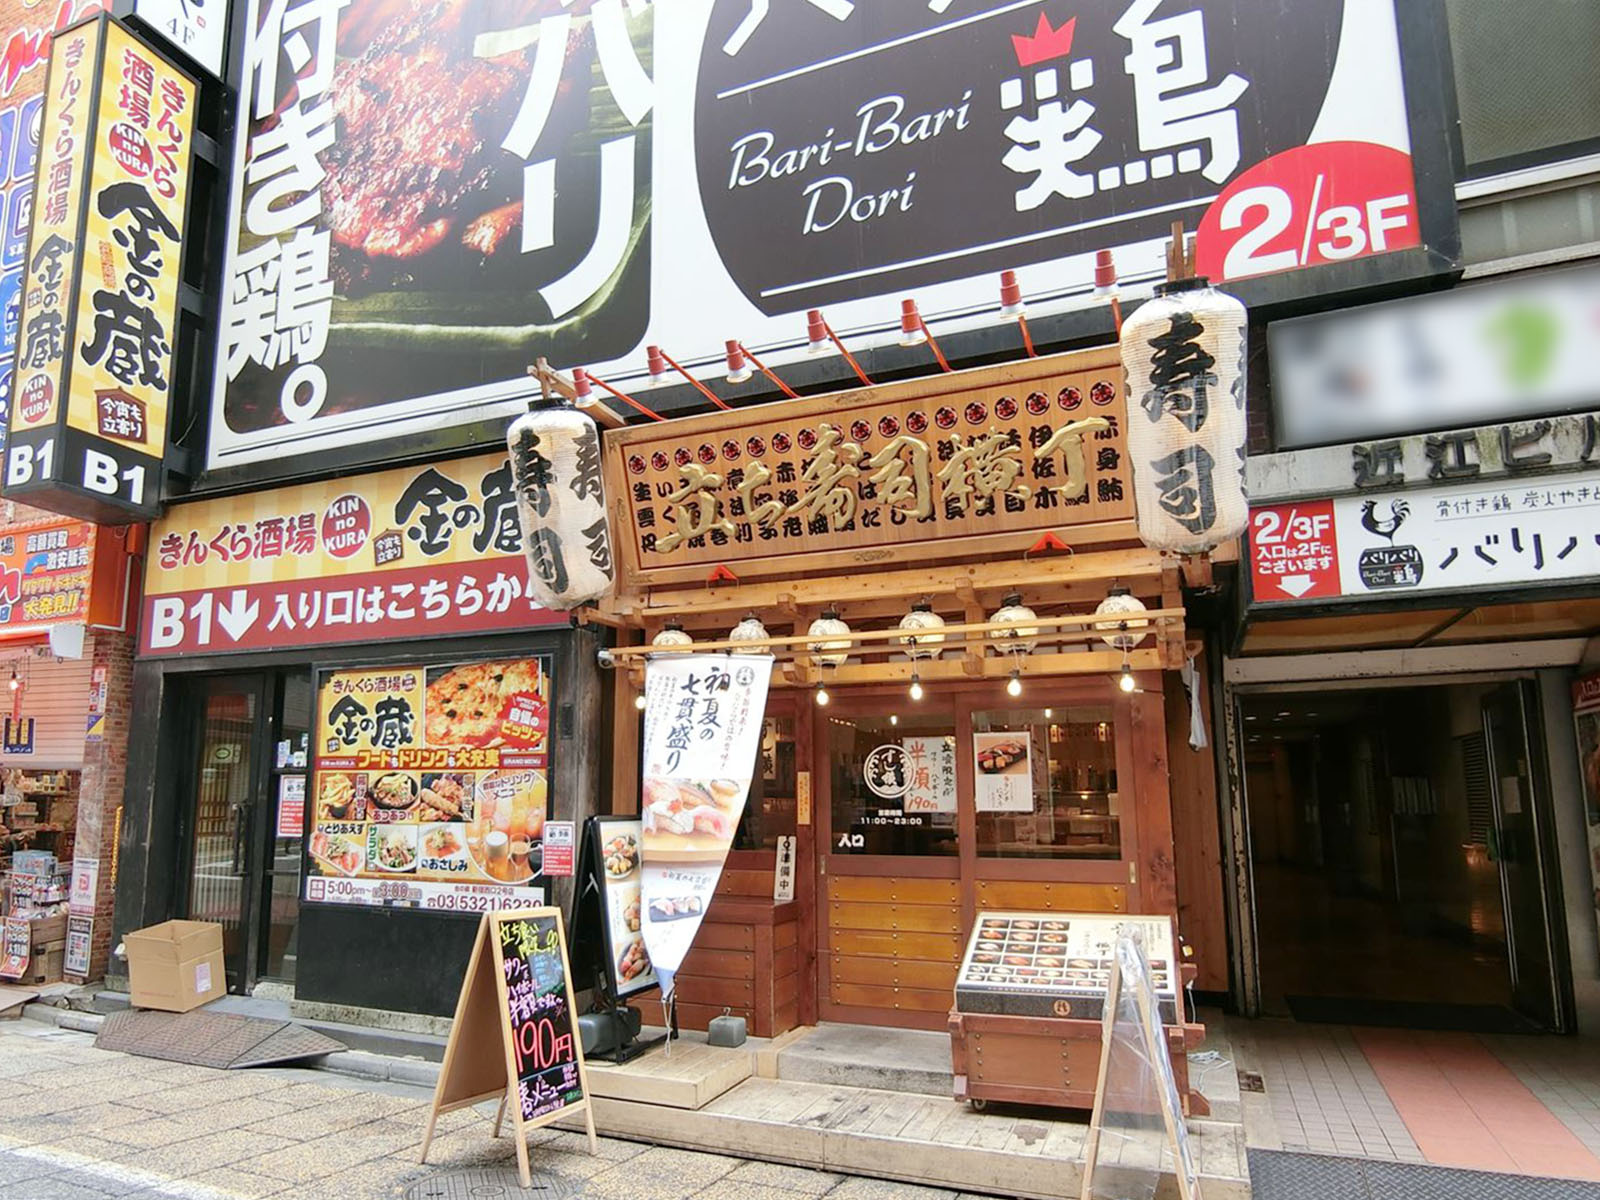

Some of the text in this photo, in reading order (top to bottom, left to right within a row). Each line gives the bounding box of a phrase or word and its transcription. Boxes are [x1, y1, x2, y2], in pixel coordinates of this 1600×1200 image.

[166, 18, 197, 45] 4F
[119, 48, 155, 129] 酒場
[44, 38, 86, 227] きんくら酒場
[116, 124, 145, 146] KIN
[122, 139, 142, 155] no
[153, 73, 187, 199] きんくら
[728, 89, 972, 190] Bari-Bari
[111, 148, 149, 175] KURA
[803, 170, 913, 236] Dori
[1219, 172, 1410, 282] 2/3F
[20, 233, 75, 371] 金の蔵
[80, 182, 182, 391] 金の蔵
[24, 374, 49, 396] KIN
[30, 389, 45, 403] no
[21, 400, 51, 421] KURA
[101, 398, 142, 422] 今宵も
[102, 417, 143, 439] 立寄り
[1139, 311, 1219, 537] 寿司
[7, 438, 55, 487] B1
[82, 448, 147, 505] B1
[329, 495, 360, 518] KIN
[336, 515, 356, 530] no
[512, 424, 570, 595] 寿司
[159, 513, 317, 570] きんくら酒場
[326, 527, 369, 551] KURA
[1254, 508, 1330, 546] 2/3F
[1256, 542, 1332, 562] 入口は2Fに
[1258, 556, 1333, 576] ございます
[150, 592, 214, 650] B1
[333, 676, 401, 695] きんくら酒場
[696, 666, 731, 742] 初夏の
[328, 694, 415, 750] 金の蔵
[664, 673, 702, 776] 七貫盛り
[358, 746, 501, 769] フードもドリンクも大充実
[838, 833, 865, 848] 入口
[428, 858, 469, 872] おさしみ
[513, 1017, 574, 1074] 190円
